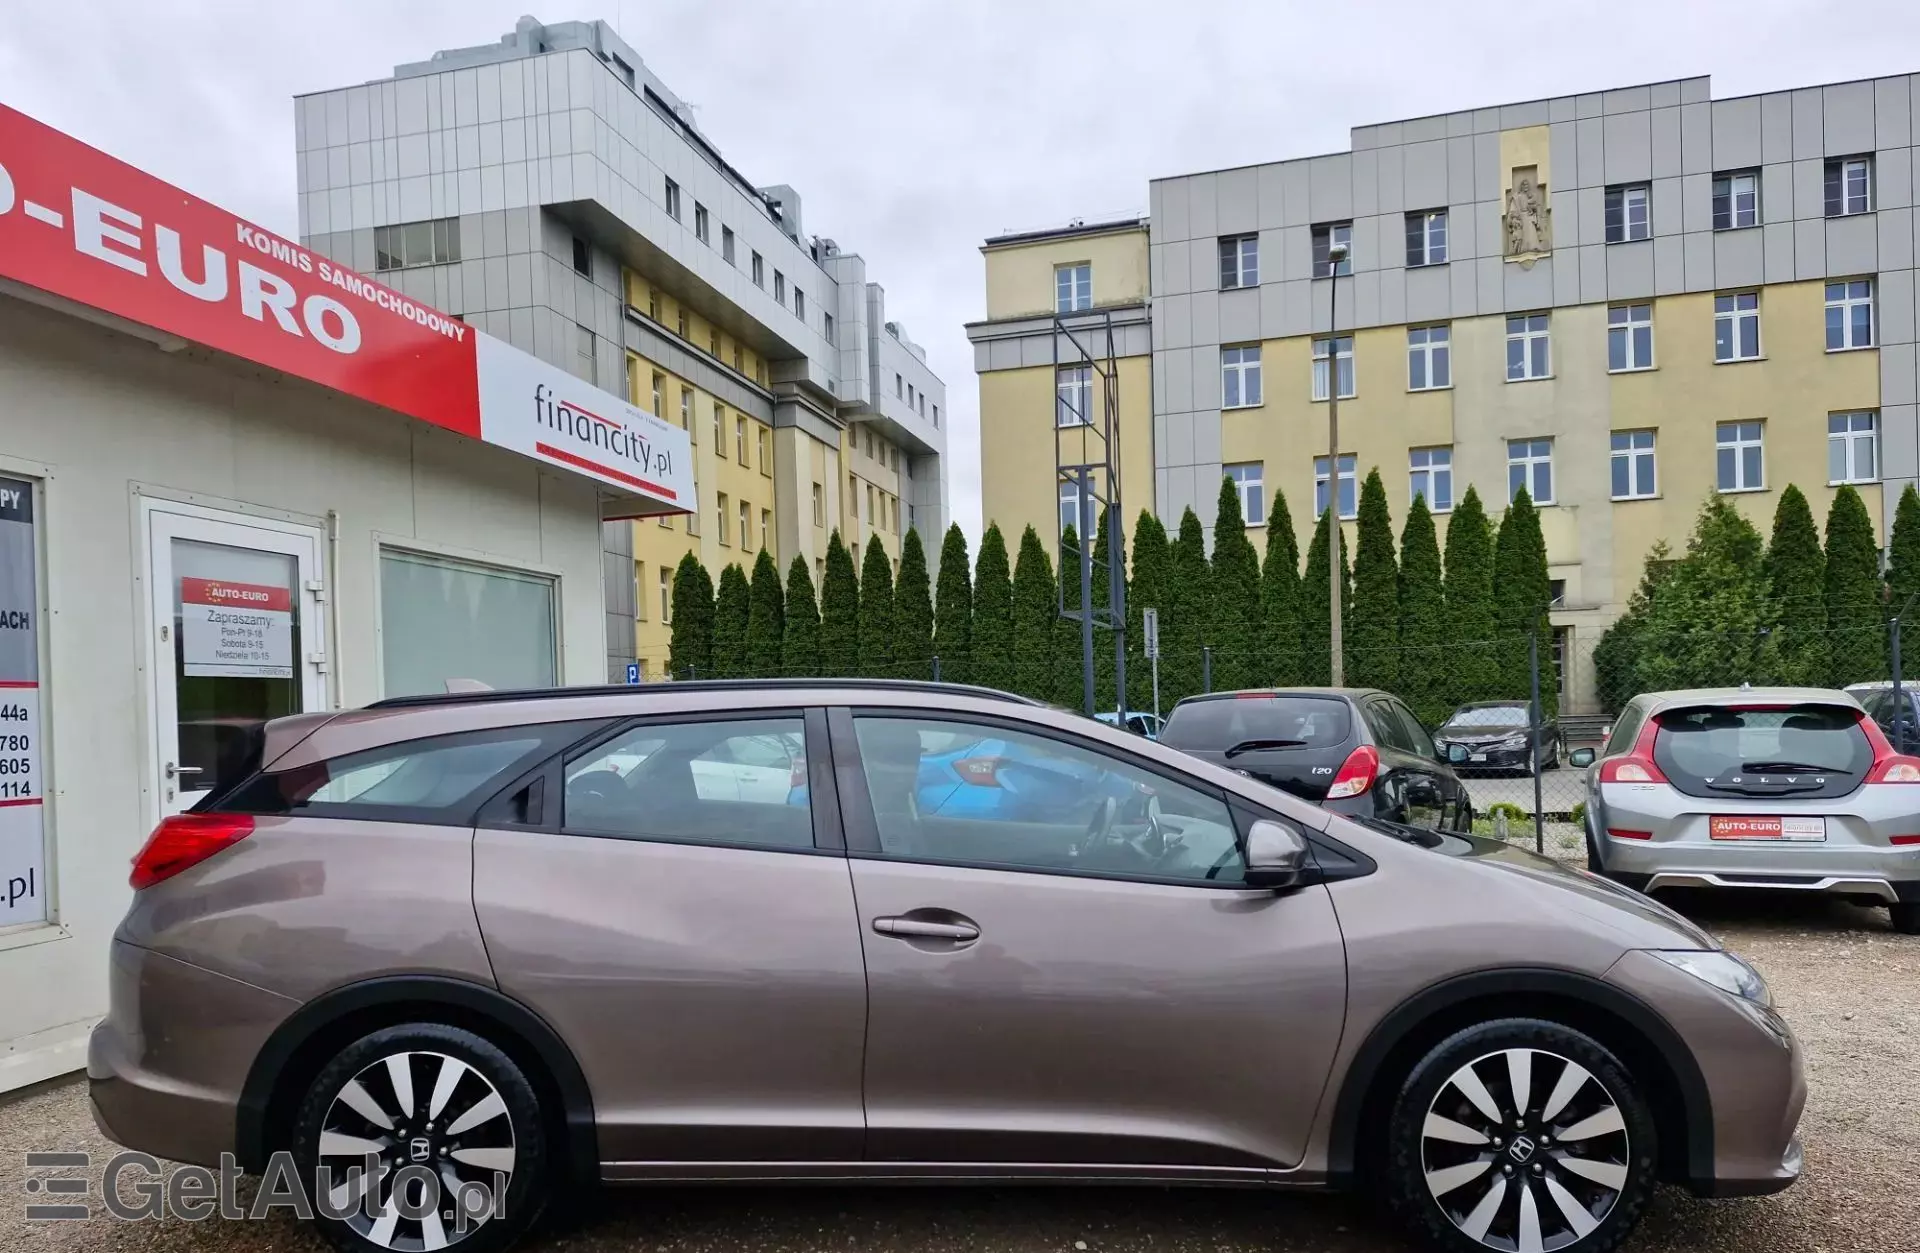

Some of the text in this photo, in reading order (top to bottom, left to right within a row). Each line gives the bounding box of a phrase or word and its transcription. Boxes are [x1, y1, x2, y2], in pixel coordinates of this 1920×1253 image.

[236, 222, 465, 343] KOMIS SAMOCHODOWY
[534, 383, 673, 478] financity.pl
[211, 587, 269, 602] AUTO-EURO
[0, 610, 30, 630] ACH
[221, 638, 264, 649] Sobota 9-15
[215, 649, 270, 661] Niedziela 10-15
[0, 704, 28, 722] 44a
[0, 735, 29, 751] 780
[0, 758, 30, 775] 605
[1704, 776, 1826, 784] VOLVO
[0, 781, 32, 798] 114
[1717, 822, 1781, 832] AUTO-EURO
[0, 867, 35, 908] .pl
